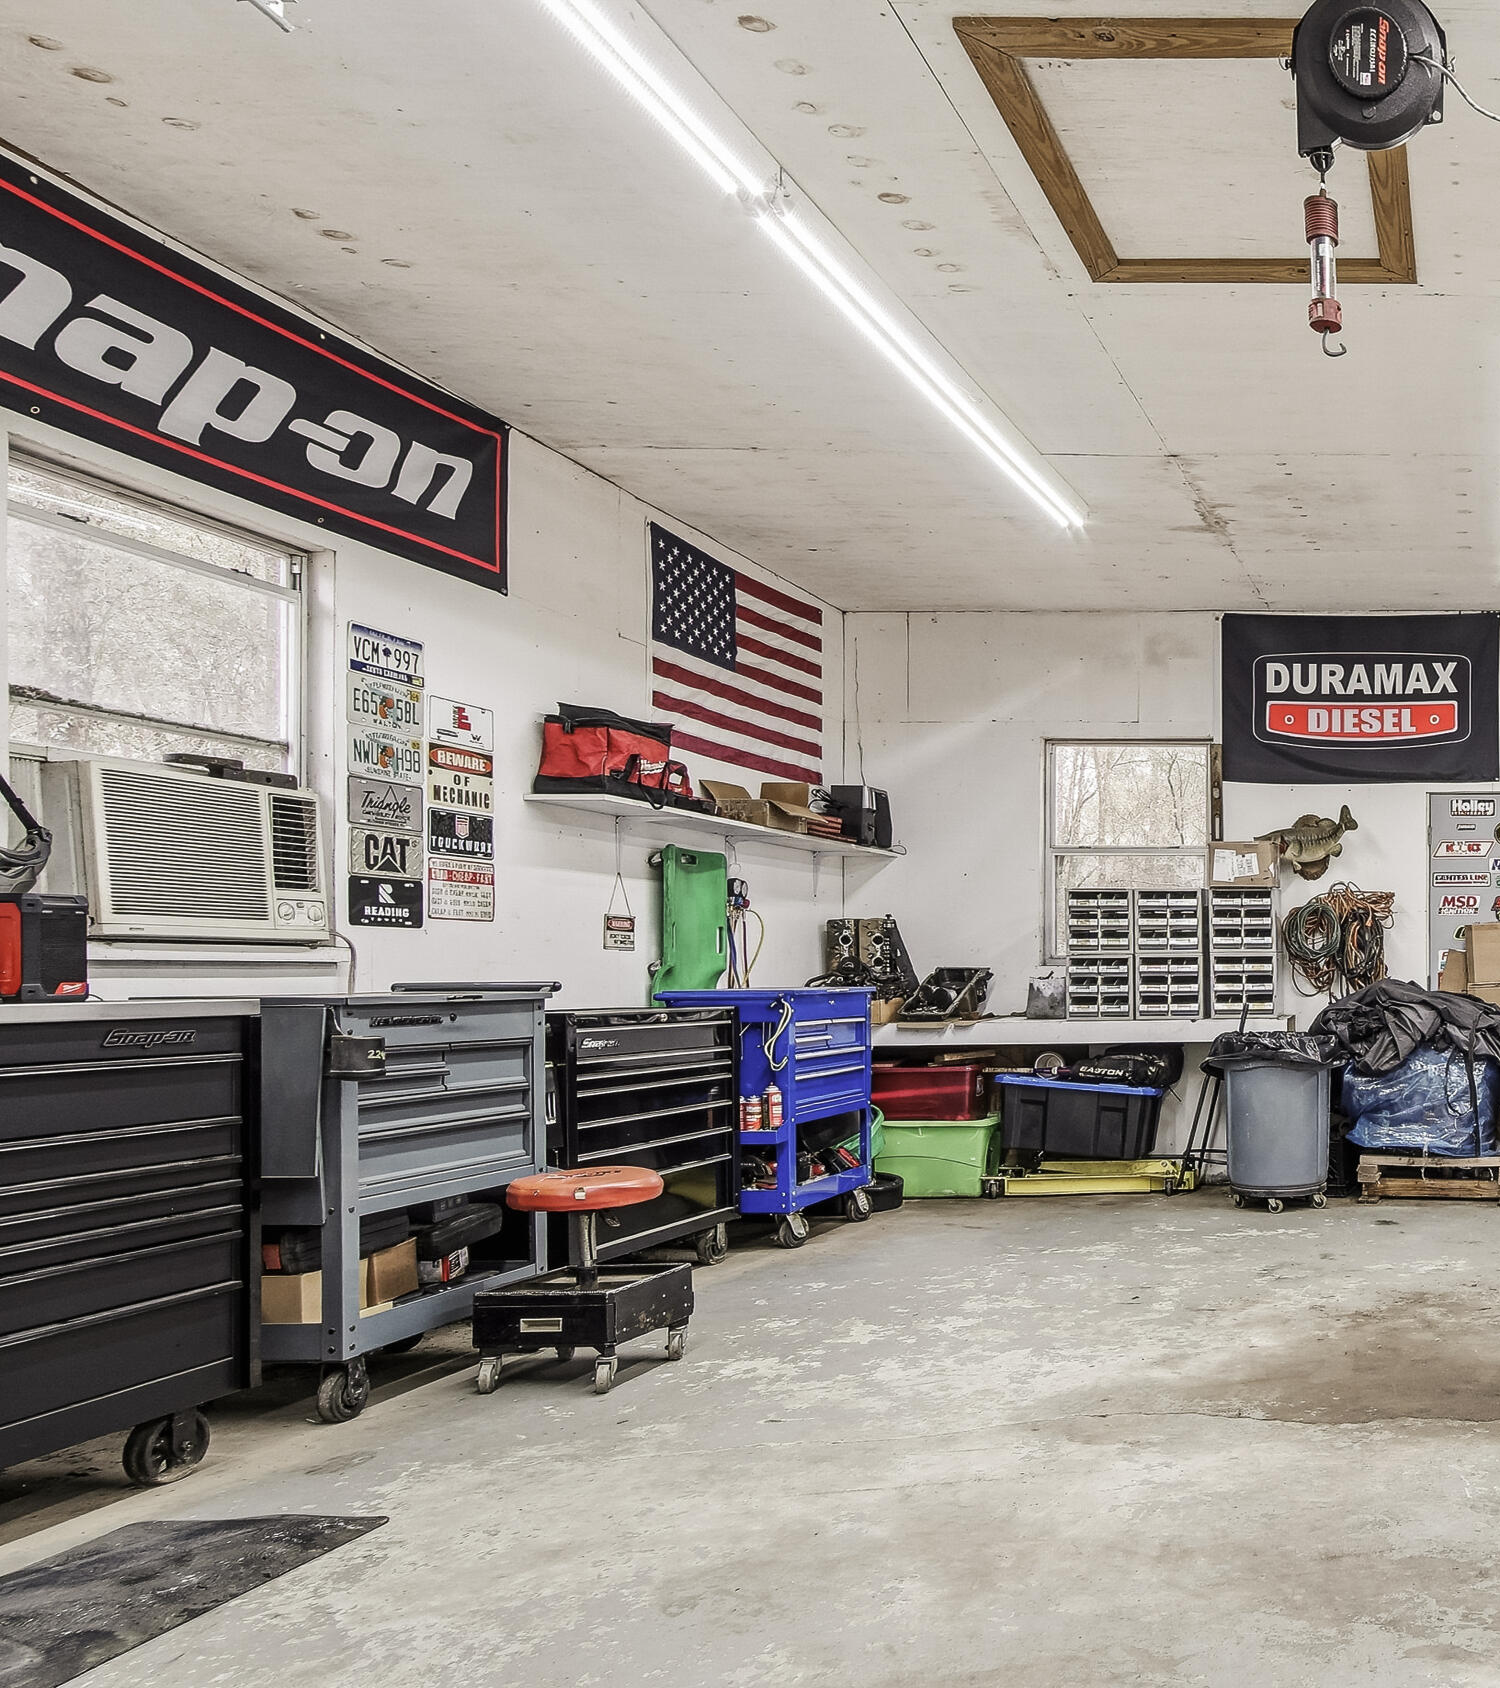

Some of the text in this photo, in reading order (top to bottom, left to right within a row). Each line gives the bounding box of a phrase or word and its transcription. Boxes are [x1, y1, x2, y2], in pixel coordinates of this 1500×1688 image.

[0, 243, 473, 520] nap-on
[354, 635, 380, 664] VCM
[394, 648, 419, 674] 997
[1266, 662, 1458, 694] DURAMAX
[354, 687, 378, 715] E65
[1307, 708, 1417, 733] DIESEL
[437, 750, 486, 771] BEWARE
[453, 774, 470, 787] OF
[361, 791, 411, 818] Triangle
[1452, 800, 1494, 815] Holley
[365, 834, 411, 873] CAT
[364, 906, 410, 918] READING
[1442, 896, 1477, 907] MSD
[103, 1028, 196, 1048] Snap-on
[1080, 1065, 1123, 1076] EASTON
